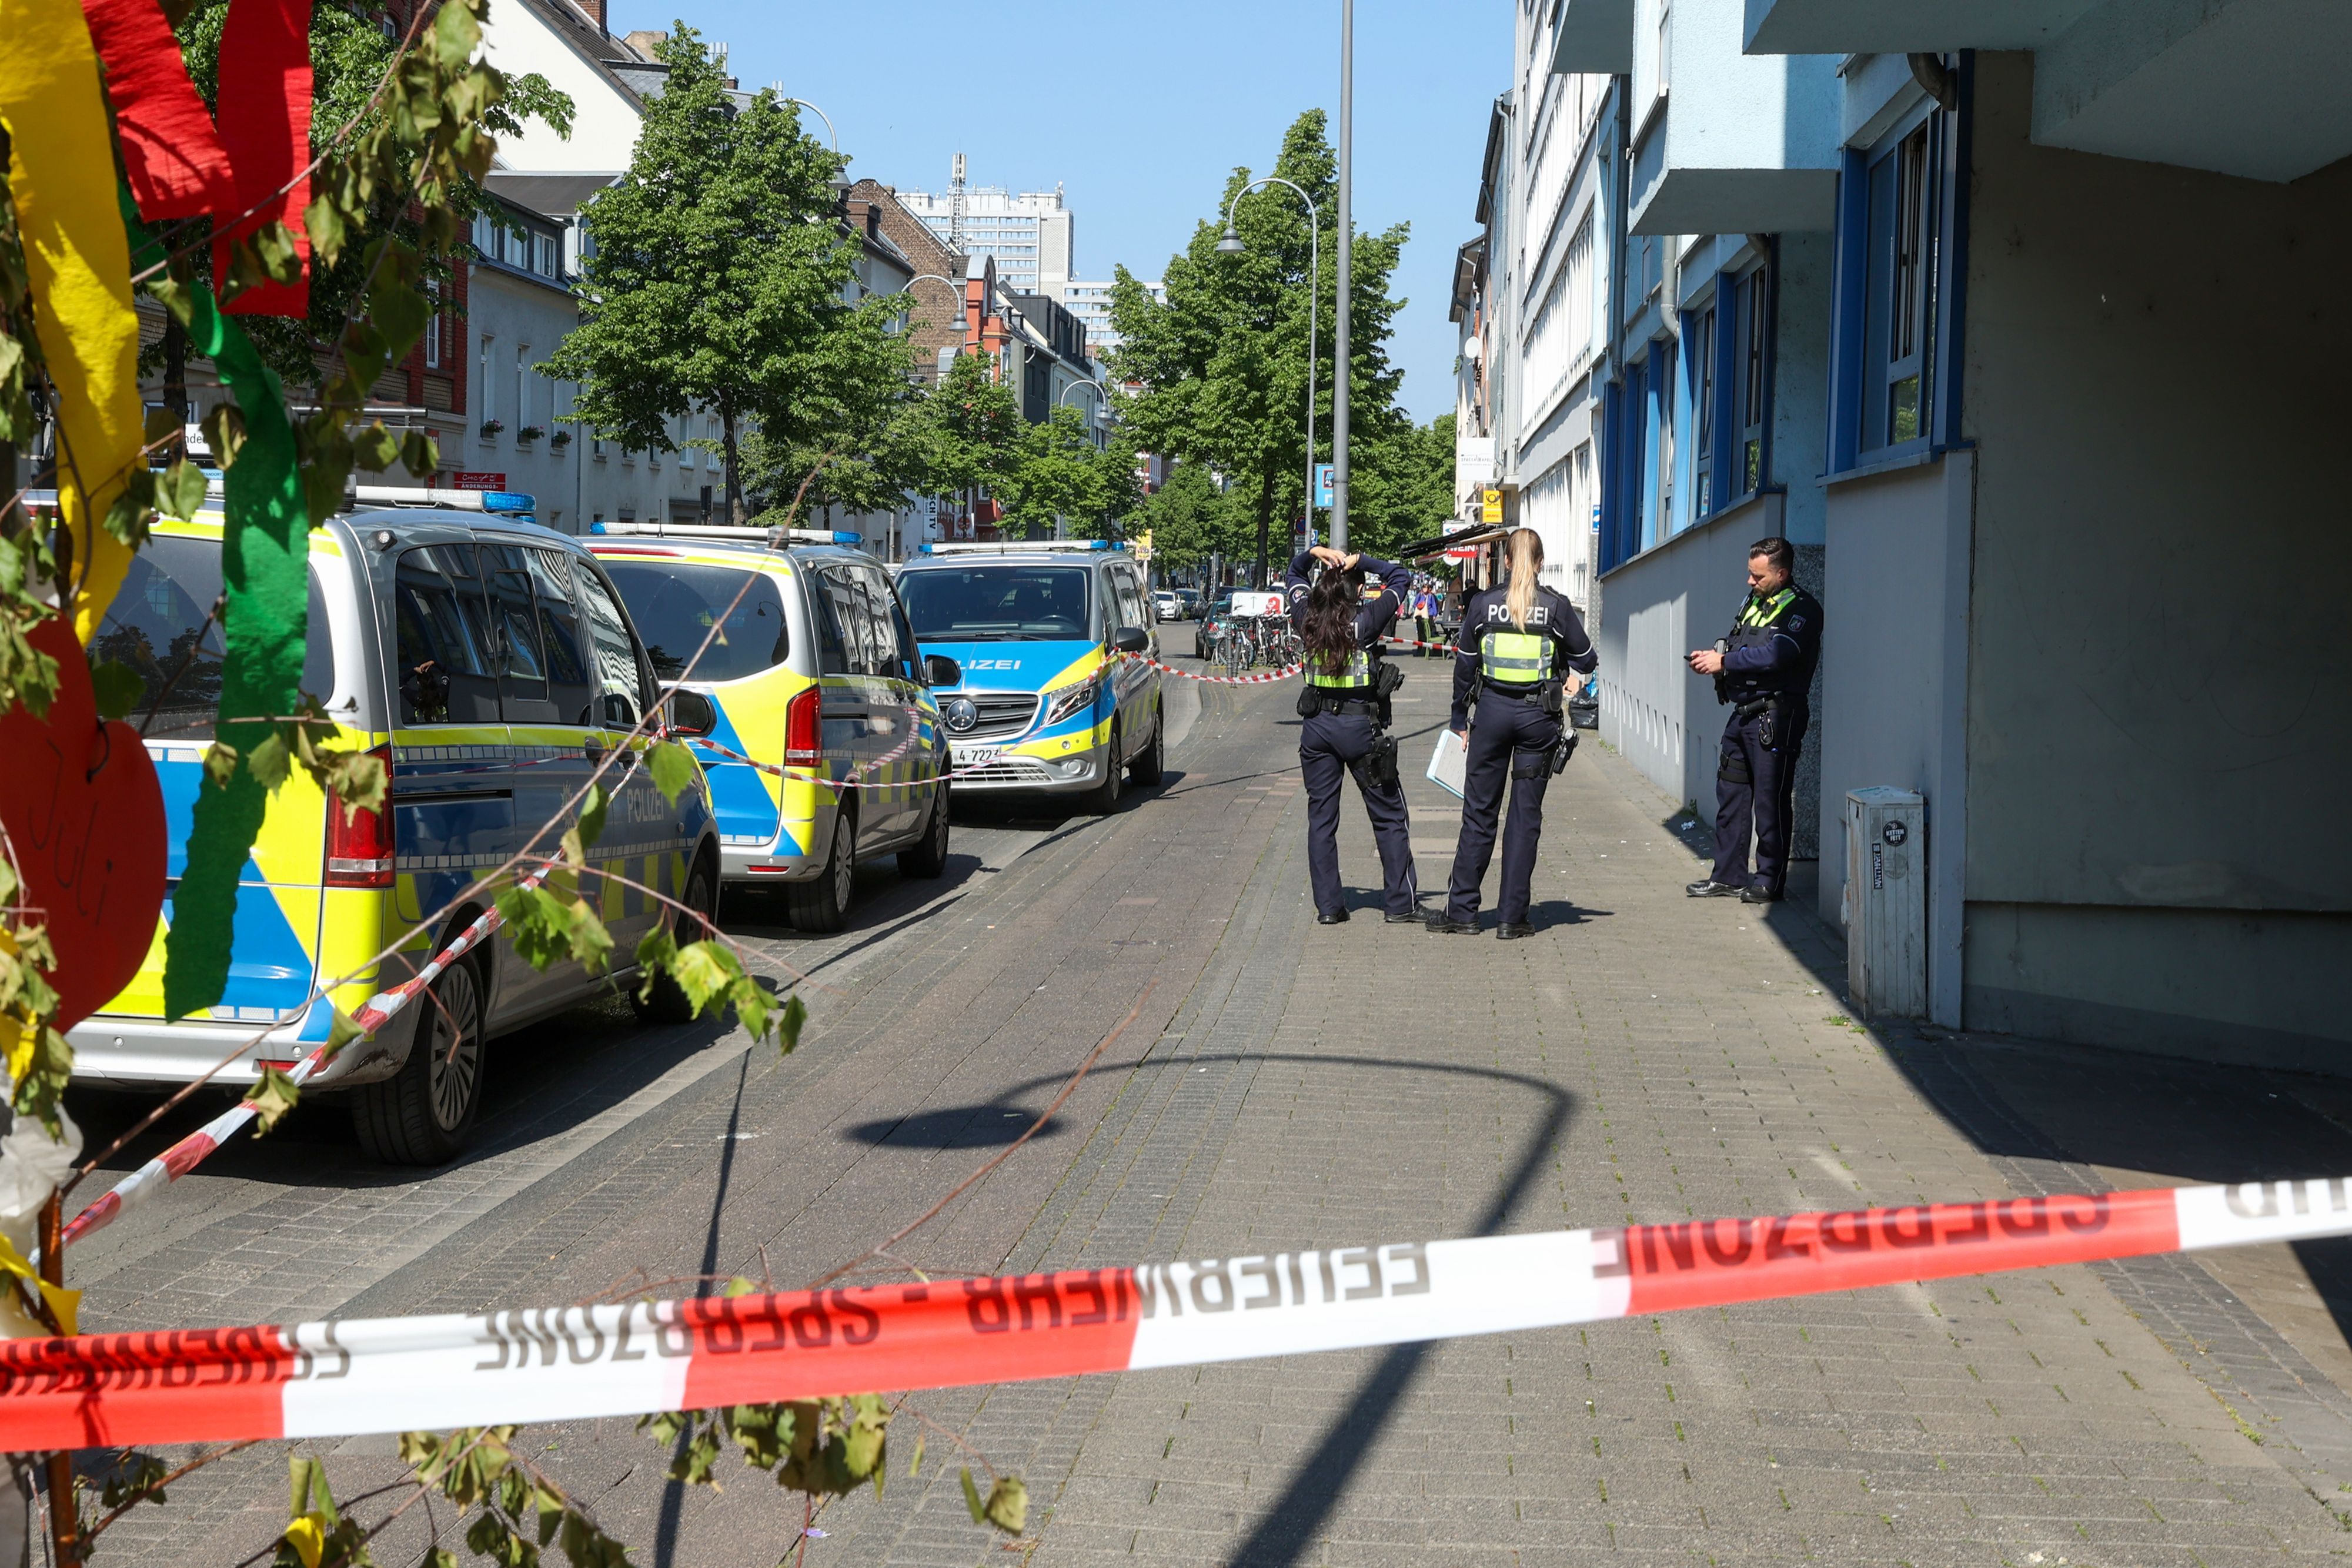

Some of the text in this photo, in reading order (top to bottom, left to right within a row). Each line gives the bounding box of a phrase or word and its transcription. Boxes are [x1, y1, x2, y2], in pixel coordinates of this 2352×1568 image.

[929, 517, 936, 529] TV
[1488, 604, 1549, 625] POZEI
[959, 660, 1021, 670] LIZEI
[627, 787, 664, 823] POLIZEI
